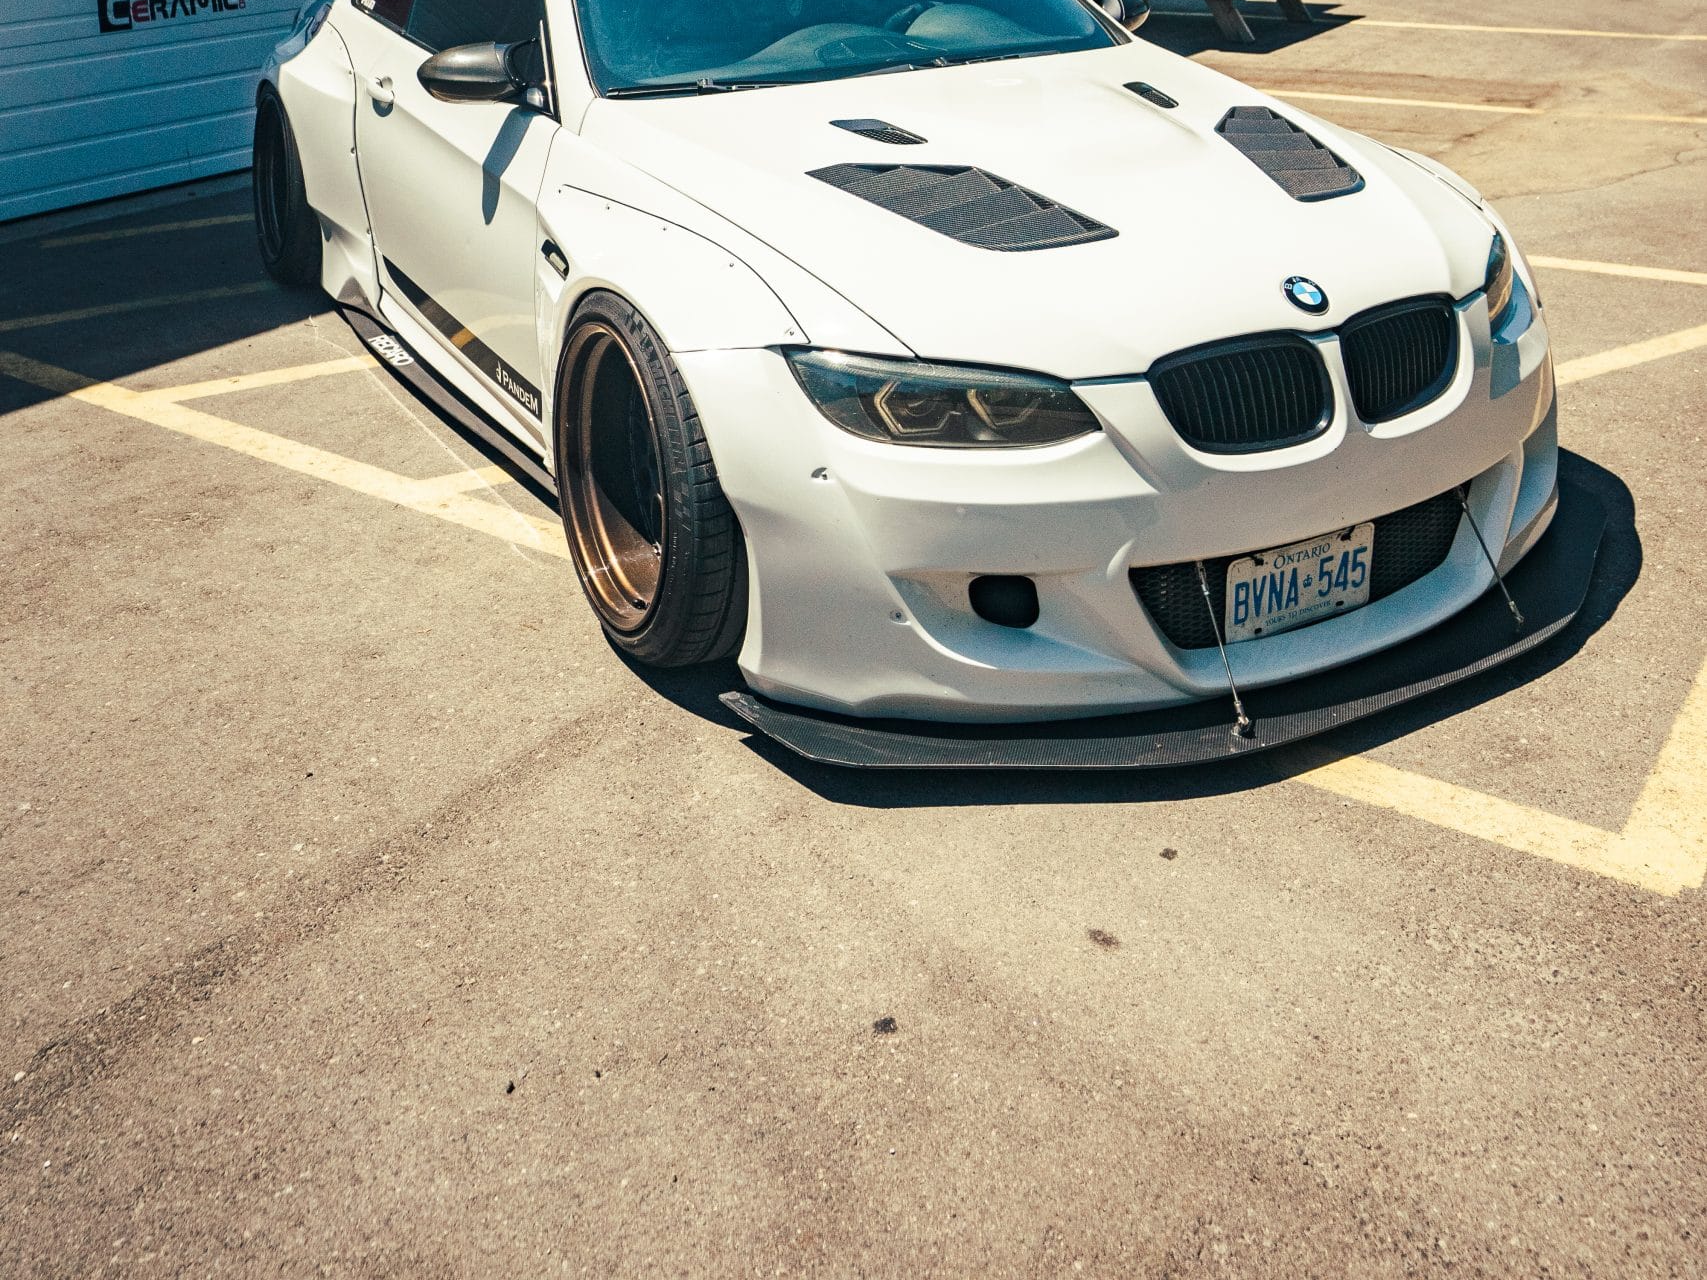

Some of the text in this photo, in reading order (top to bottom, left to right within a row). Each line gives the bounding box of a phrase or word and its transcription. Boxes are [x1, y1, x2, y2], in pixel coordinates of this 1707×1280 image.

[502, 369, 539, 417] PANDEM
[1273, 542, 1331, 570] ONTARIO
[1233, 546, 1368, 626] BVNA 545
